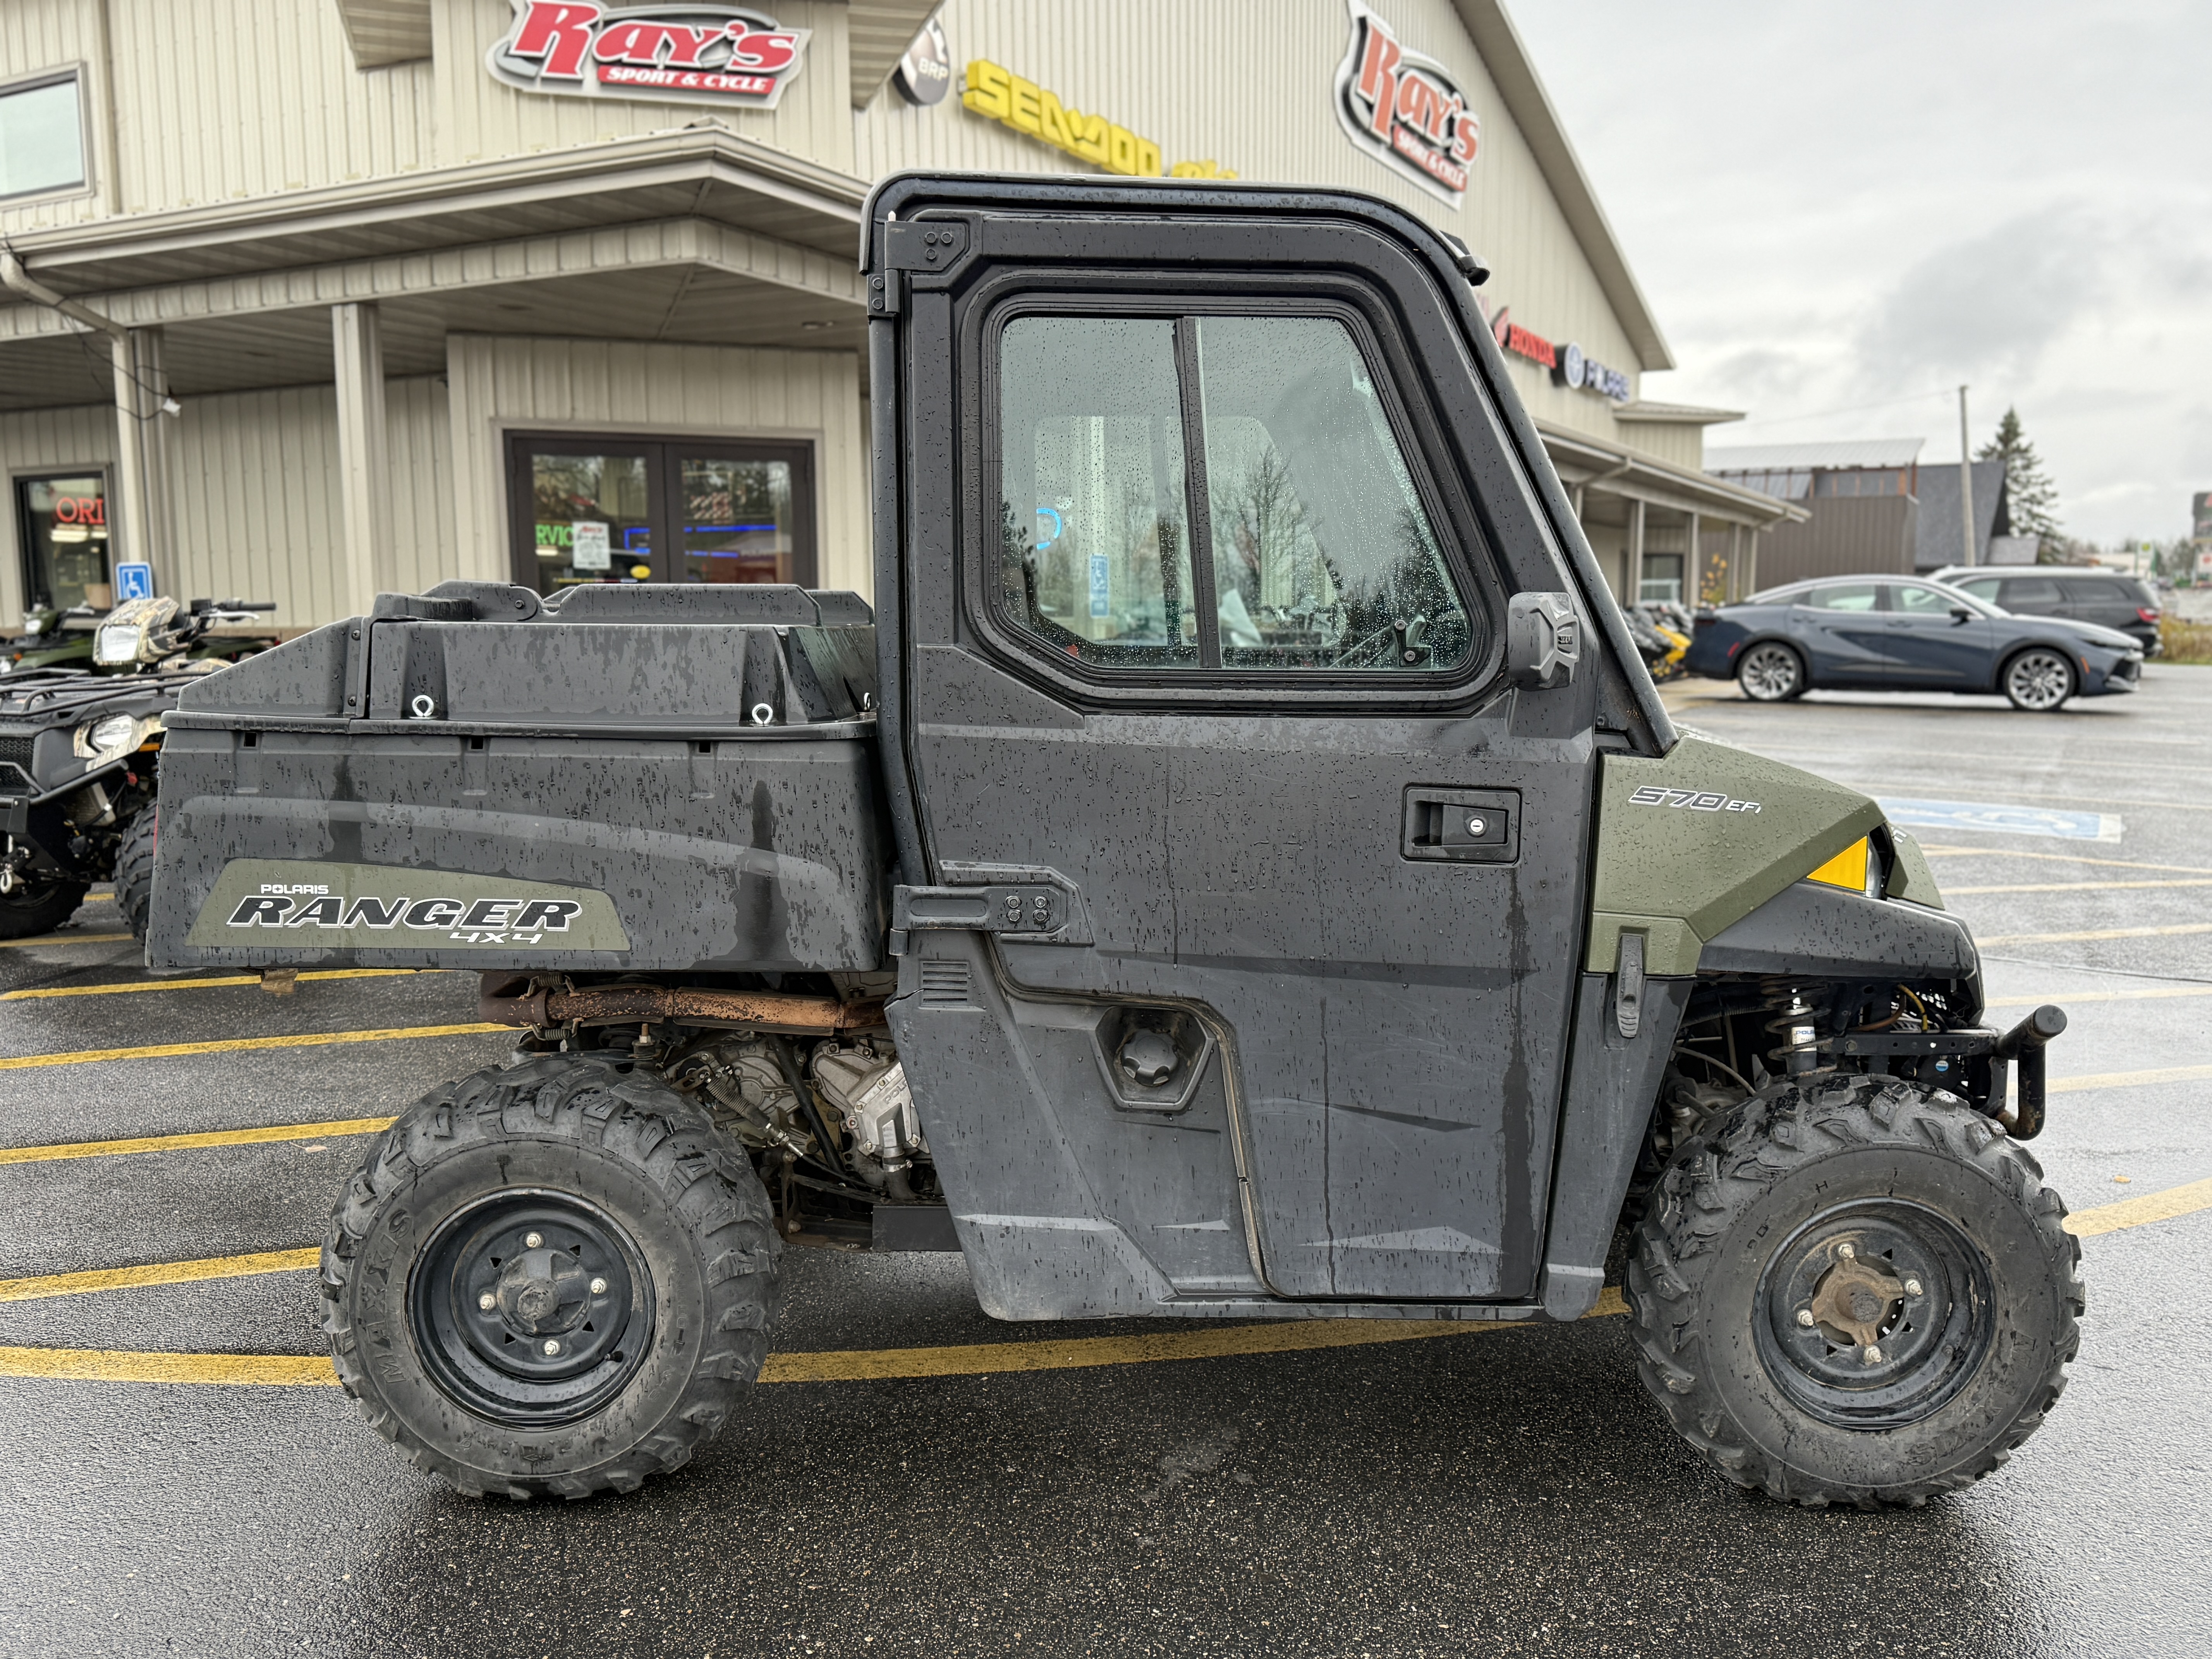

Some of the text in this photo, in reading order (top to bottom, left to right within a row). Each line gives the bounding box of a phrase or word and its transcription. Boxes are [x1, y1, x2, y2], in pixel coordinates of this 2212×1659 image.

[509, 0, 800, 80] Ray's
[606, 66, 769, 91] SPORT & CYCLE
[919, 57, 949, 81] BRP
[1357, 20, 1480, 166] Ray's
[1509, 323, 1556, 369] HONDA
[1628, 785, 1761, 814] 570 EFI
[261, 884, 329, 895] POLARIS
[226, 895, 582, 933] RANGER
[449, 931, 543, 944] 4X4
[361, 1209, 414, 1383] MAXXIS
